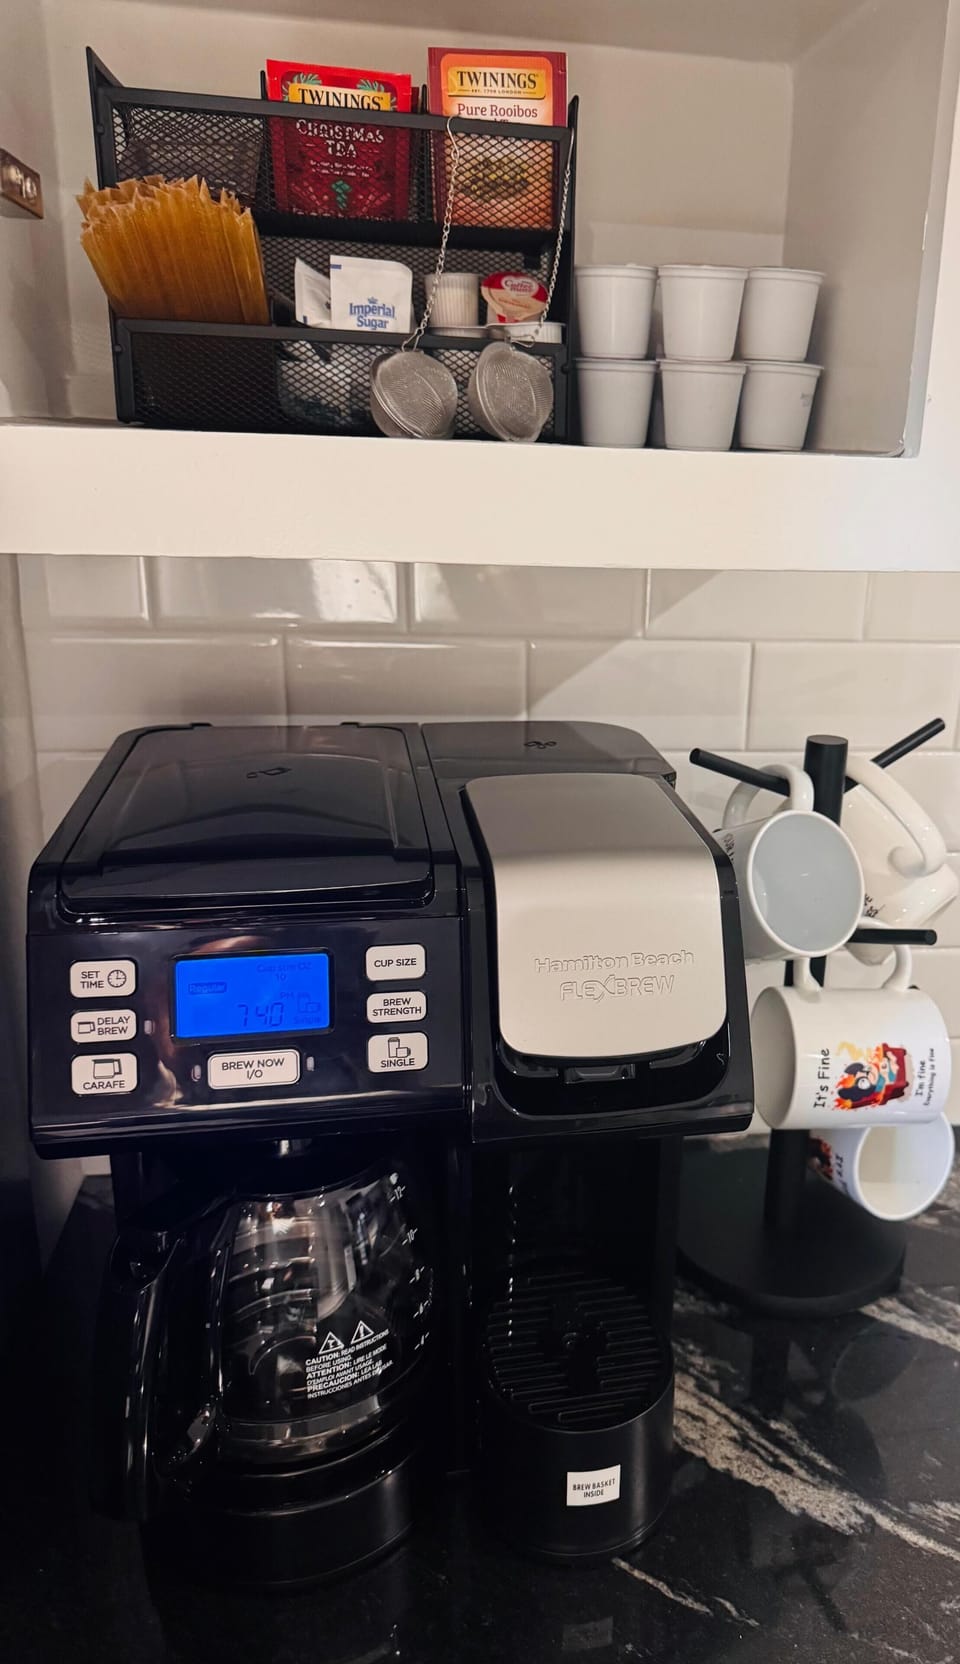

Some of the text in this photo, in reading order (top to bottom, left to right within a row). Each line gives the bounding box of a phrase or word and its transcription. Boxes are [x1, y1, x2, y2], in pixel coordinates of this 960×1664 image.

[457, 70, 537, 89] TWININGS
[298, 87, 382, 111] TWININGS
[457, 103, 538, 118] Pure Rooibos
[349, 303, 395, 319] Imperial
[357, 315, 389, 331] Sugar
[373, 957, 417, 968] CUP SIZE
[535, 950, 694, 973] Hamilton Beach
[81, 970, 100, 979] SET
[80, 980, 105, 989] TIME
[559, 974, 675, 1002] FLEXBREW
[383, 997, 412, 1007] BREW
[372, 1006, 422, 1017] STRENGTH
[97, 1015, 130, 1026] DELAY
[97, 1026, 128, 1036] BREW
[221, 1057, 285, 1071] BREW NOW
[380, 1058, 415, 1068] SINGLE
[246, 1069, 263, 1080] I/O
[813, 1047, 830, 1108] It's Fine
[82, 1080, 126, 1090] CARAFE
[305, 1328, 389, 1366] CAUTION: READ INSTRUCTIONS
[306, 1361, 331, 1373] BEFORE
[306, 1361, 352, 1380] ATTENTION:
[336, 1367, 353, 1378] AVANT
[307, 1371, 360, 1392] PRECAUCION:
[308, 1381, 352, 1399] INSTRUCCIONES
[572, 1478, 616, 1491] BREW BASKET
[583, 1489, 604, 1498] INSIDE
